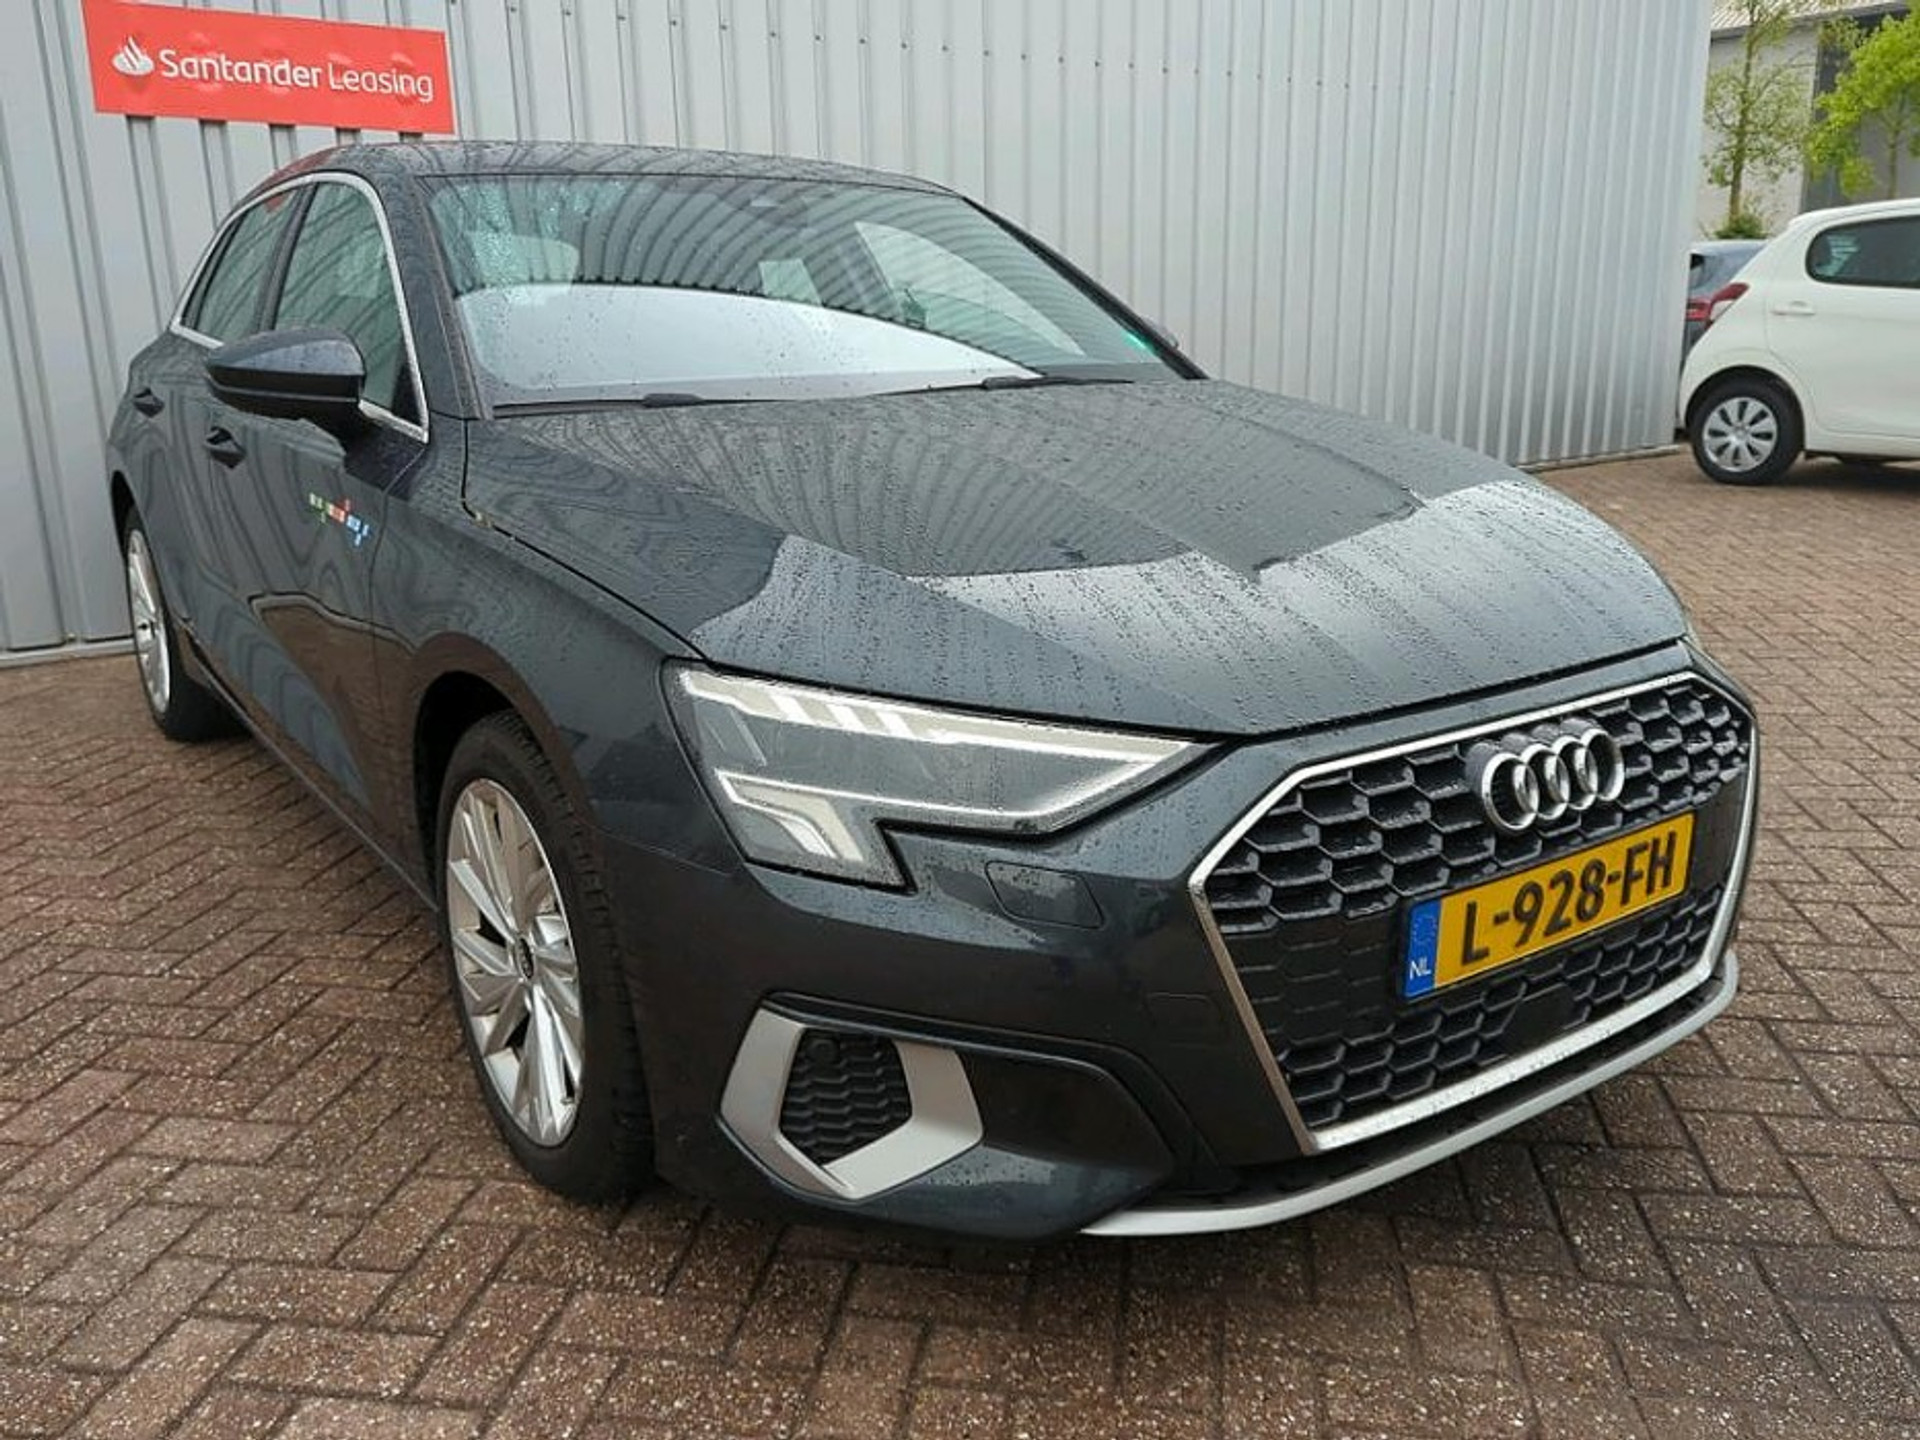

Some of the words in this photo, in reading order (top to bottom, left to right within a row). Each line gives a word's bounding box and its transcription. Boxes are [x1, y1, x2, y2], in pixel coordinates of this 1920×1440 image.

[159, 49, 322, 88] Santander
[329, 63, 433, 102] Leasing
[1462, 831, 1677, 966] L-928-FH
[1409, 957, 1431, 980] NL
